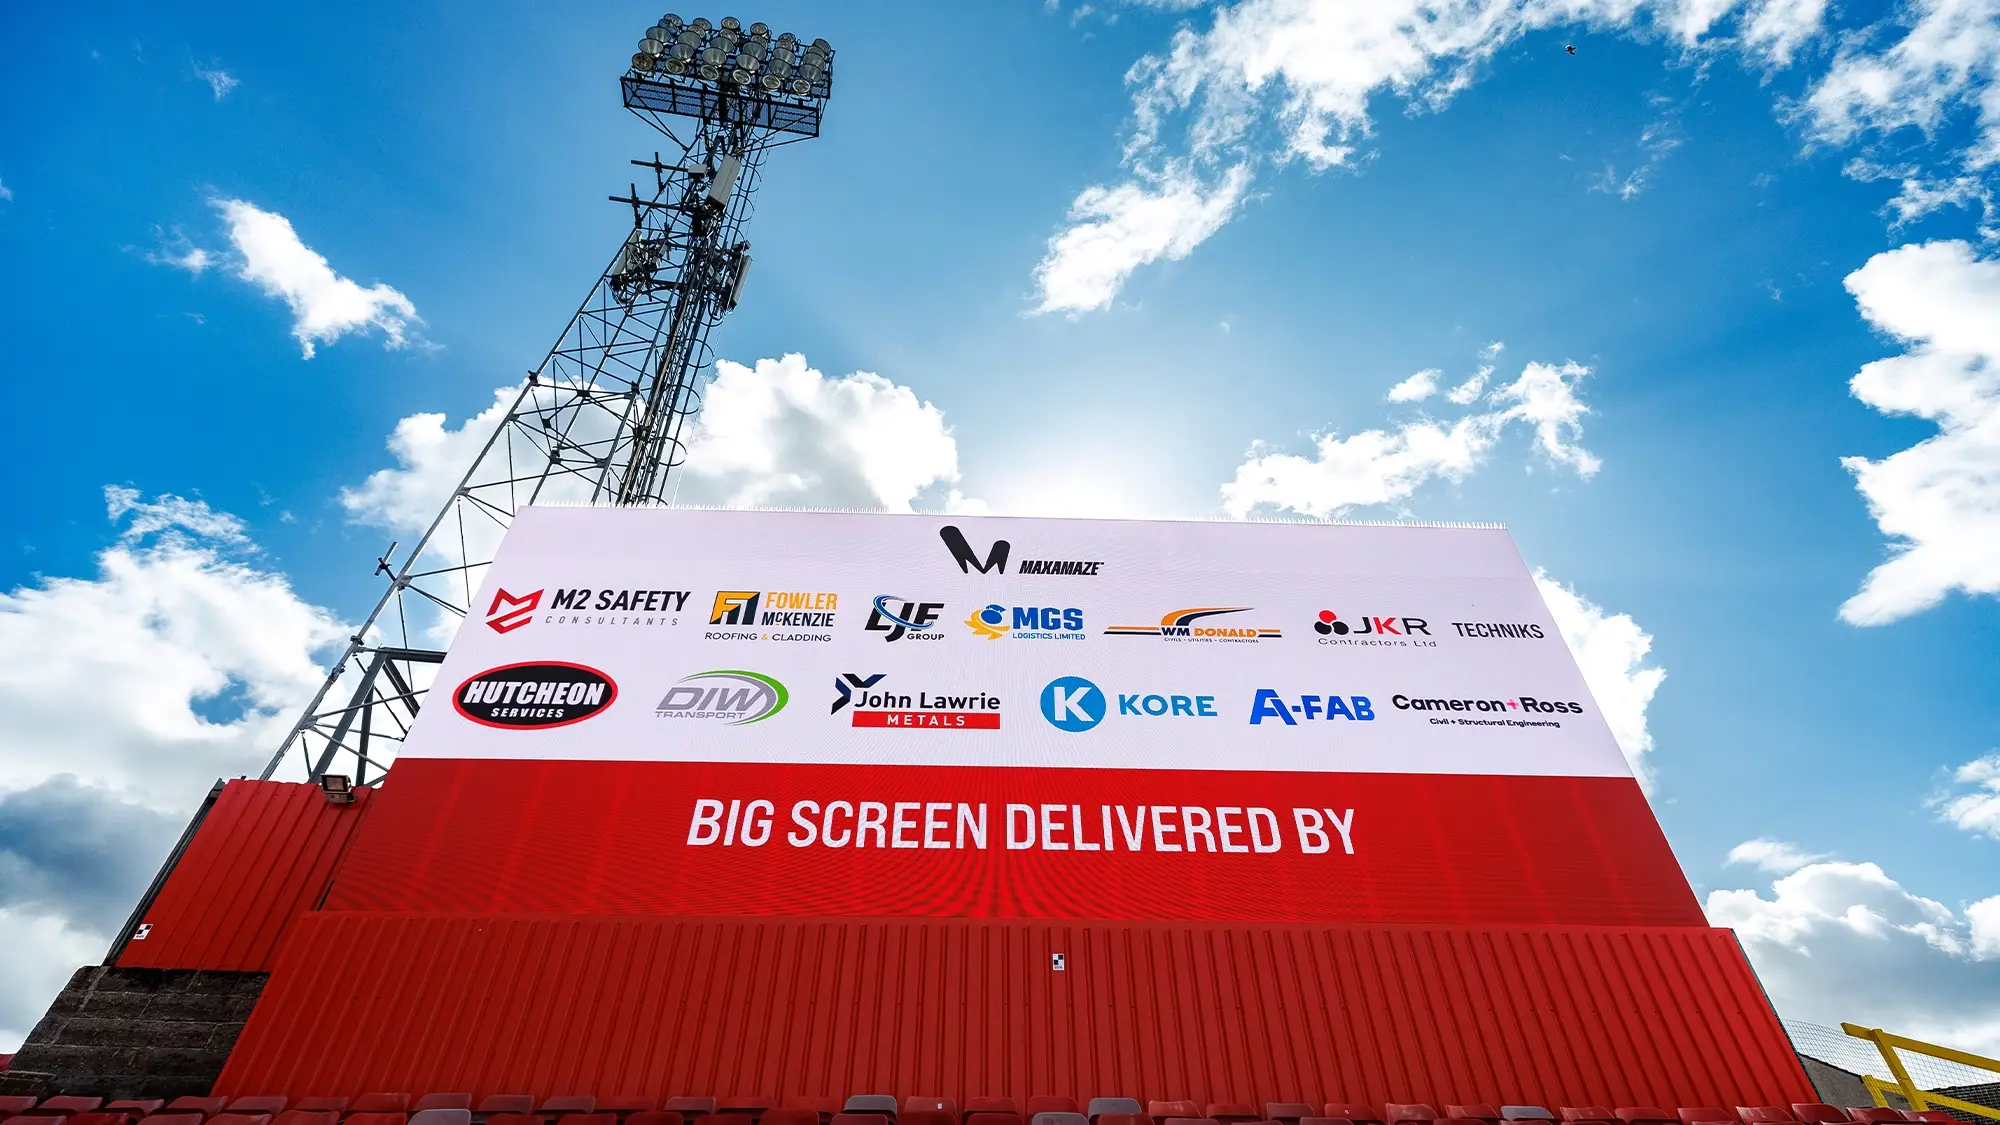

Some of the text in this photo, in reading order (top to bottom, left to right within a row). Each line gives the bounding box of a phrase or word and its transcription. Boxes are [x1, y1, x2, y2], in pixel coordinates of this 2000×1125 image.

[1018, 560, 1101, 576] MAXAMAZE
[550, 588, 692, 612] M2 SAFETY
[765, 591, 838, 610] FOWLER
[545, 615, 680, 627] CONSULTANTS
[864, 602, 945, 643] LJF
[1012, 606, 1084, 632] MGS
[1353, 616, 1432, 636] JKR
[704, 631, 832, 642] ROOFING & CLADDING
[906, 632, 945, 641] GROUP
[1012, 632, 1086, 641] LOGISTICS LIMITED
[1161, 627, 1257, 638] WM DONALD
[1451, 622, 1545, 639] TECHNIKS
[1318, 637, 1437, 648] Contractors Ltd
[463, 681, 606, 706] HUTCHEON
[656, 686, 768, 711] DIW
[854, 690, 1001, 710] John Lawrie
[490, 707, 565, 719] SERVICES
[1119, 694, 1218, 717] KORE
[1249, 688, 1376, 726] A-FAB
[654, 710, 746, 720] TRANSPORT
[886, 714, 966, 727] METALS
[1429, 717, 1450, 726] Civil
[1457, 718, 1505, 727] Structural
[1506, 719, 1561, 729] Engineering
[686, 798, 1356, 856] BIG SCREEN DELIVERED BY
